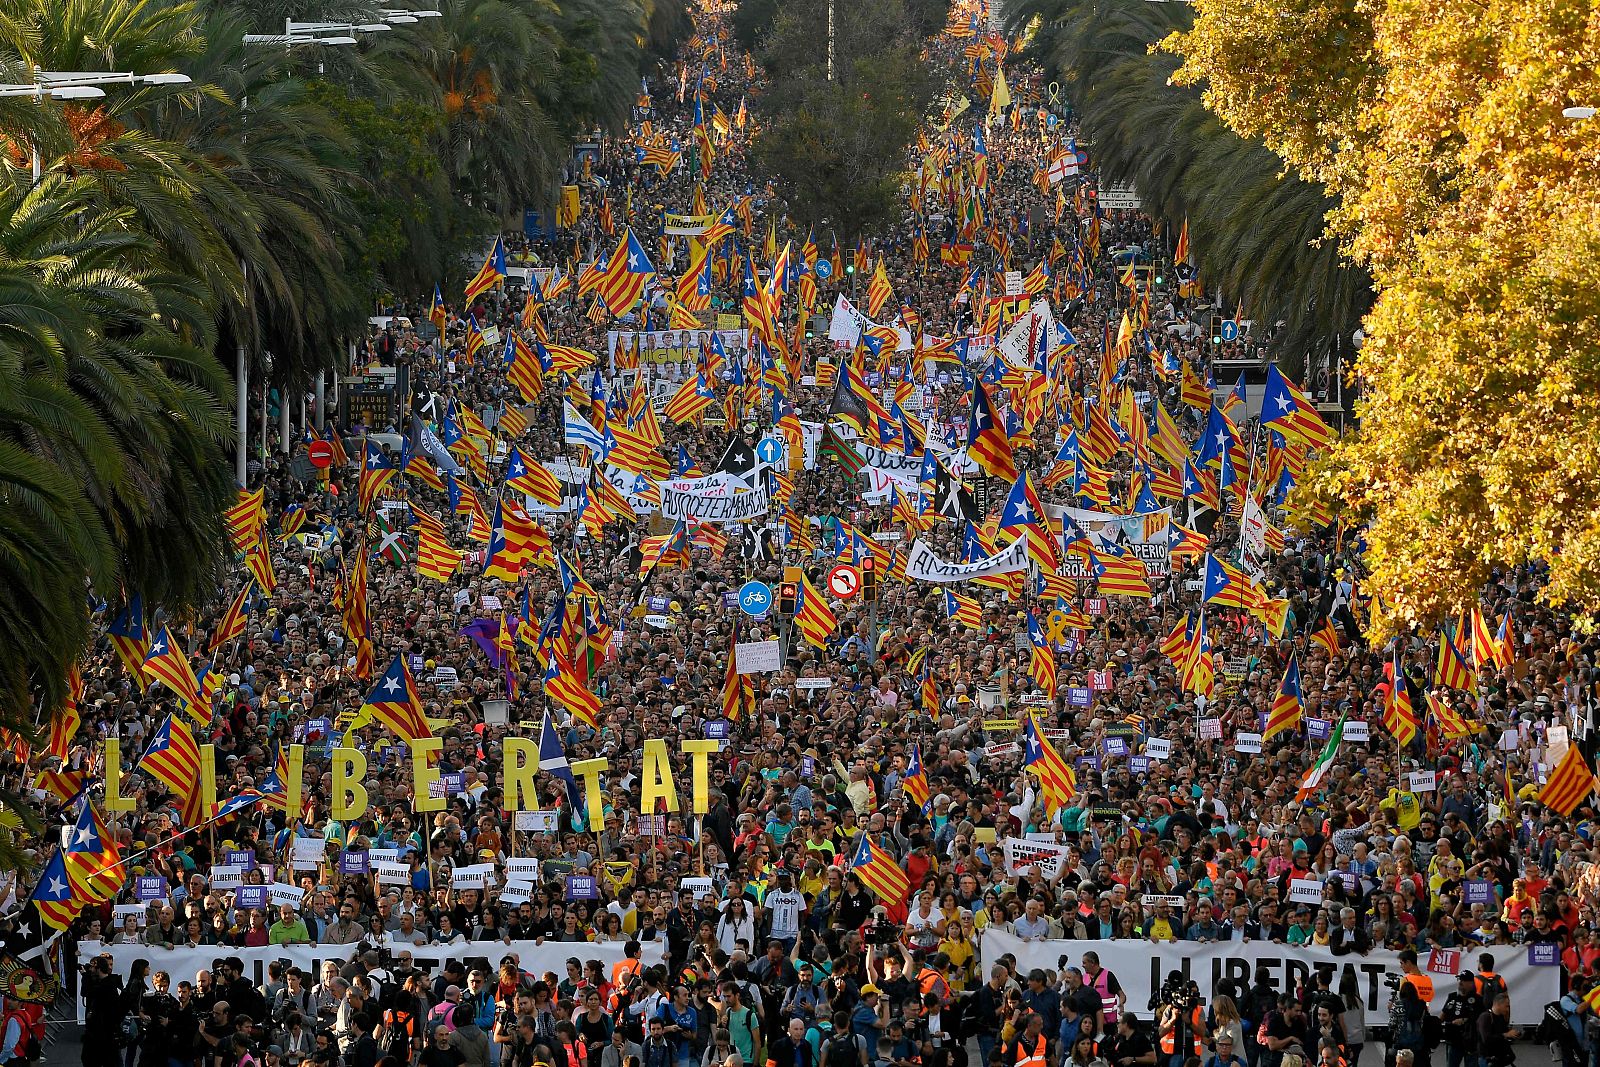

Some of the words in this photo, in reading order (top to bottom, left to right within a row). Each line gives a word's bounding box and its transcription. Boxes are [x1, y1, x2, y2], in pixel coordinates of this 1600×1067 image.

[667, 216, 705, 229] Llibertat
[673, 482, 690, 491] NO
[705, 477, 720, 488] la
[470, 552, 480, 562] SIT
[1089, 600, 1100, 609] SIT
[1094, 674, 1106, 684] SIT
[1073, 689, 1088, 697] PROU
[1107, 739, 1123, 747] PROU
[1148, 744, 1168, 752] LLIBERTAT
[1013, 844, 1058, 857] LLIBERTAT
[231, 853, 248, 862] PROU
[346, 854, 362, 862] PROU
[1013, 851, 1057, 865] PRESOS
[380, 869, 407, 878] LLIBERTAT
[142, 878, 160, 888] PROU
[573, 879, 590, 888] PROU
[503, 887, 529, 897] LLIBERTAT
[1292, 886, 1320, 895] LLIBERTAT
[1470, 884, 1488, 892] PROU
[242, 889, 260, 897] PROU
[274, 889, 300, 902] LLIBERTAT
[1535, 946, 1552, 954] PROU
[1435, 951, 1452, 963] SIT
